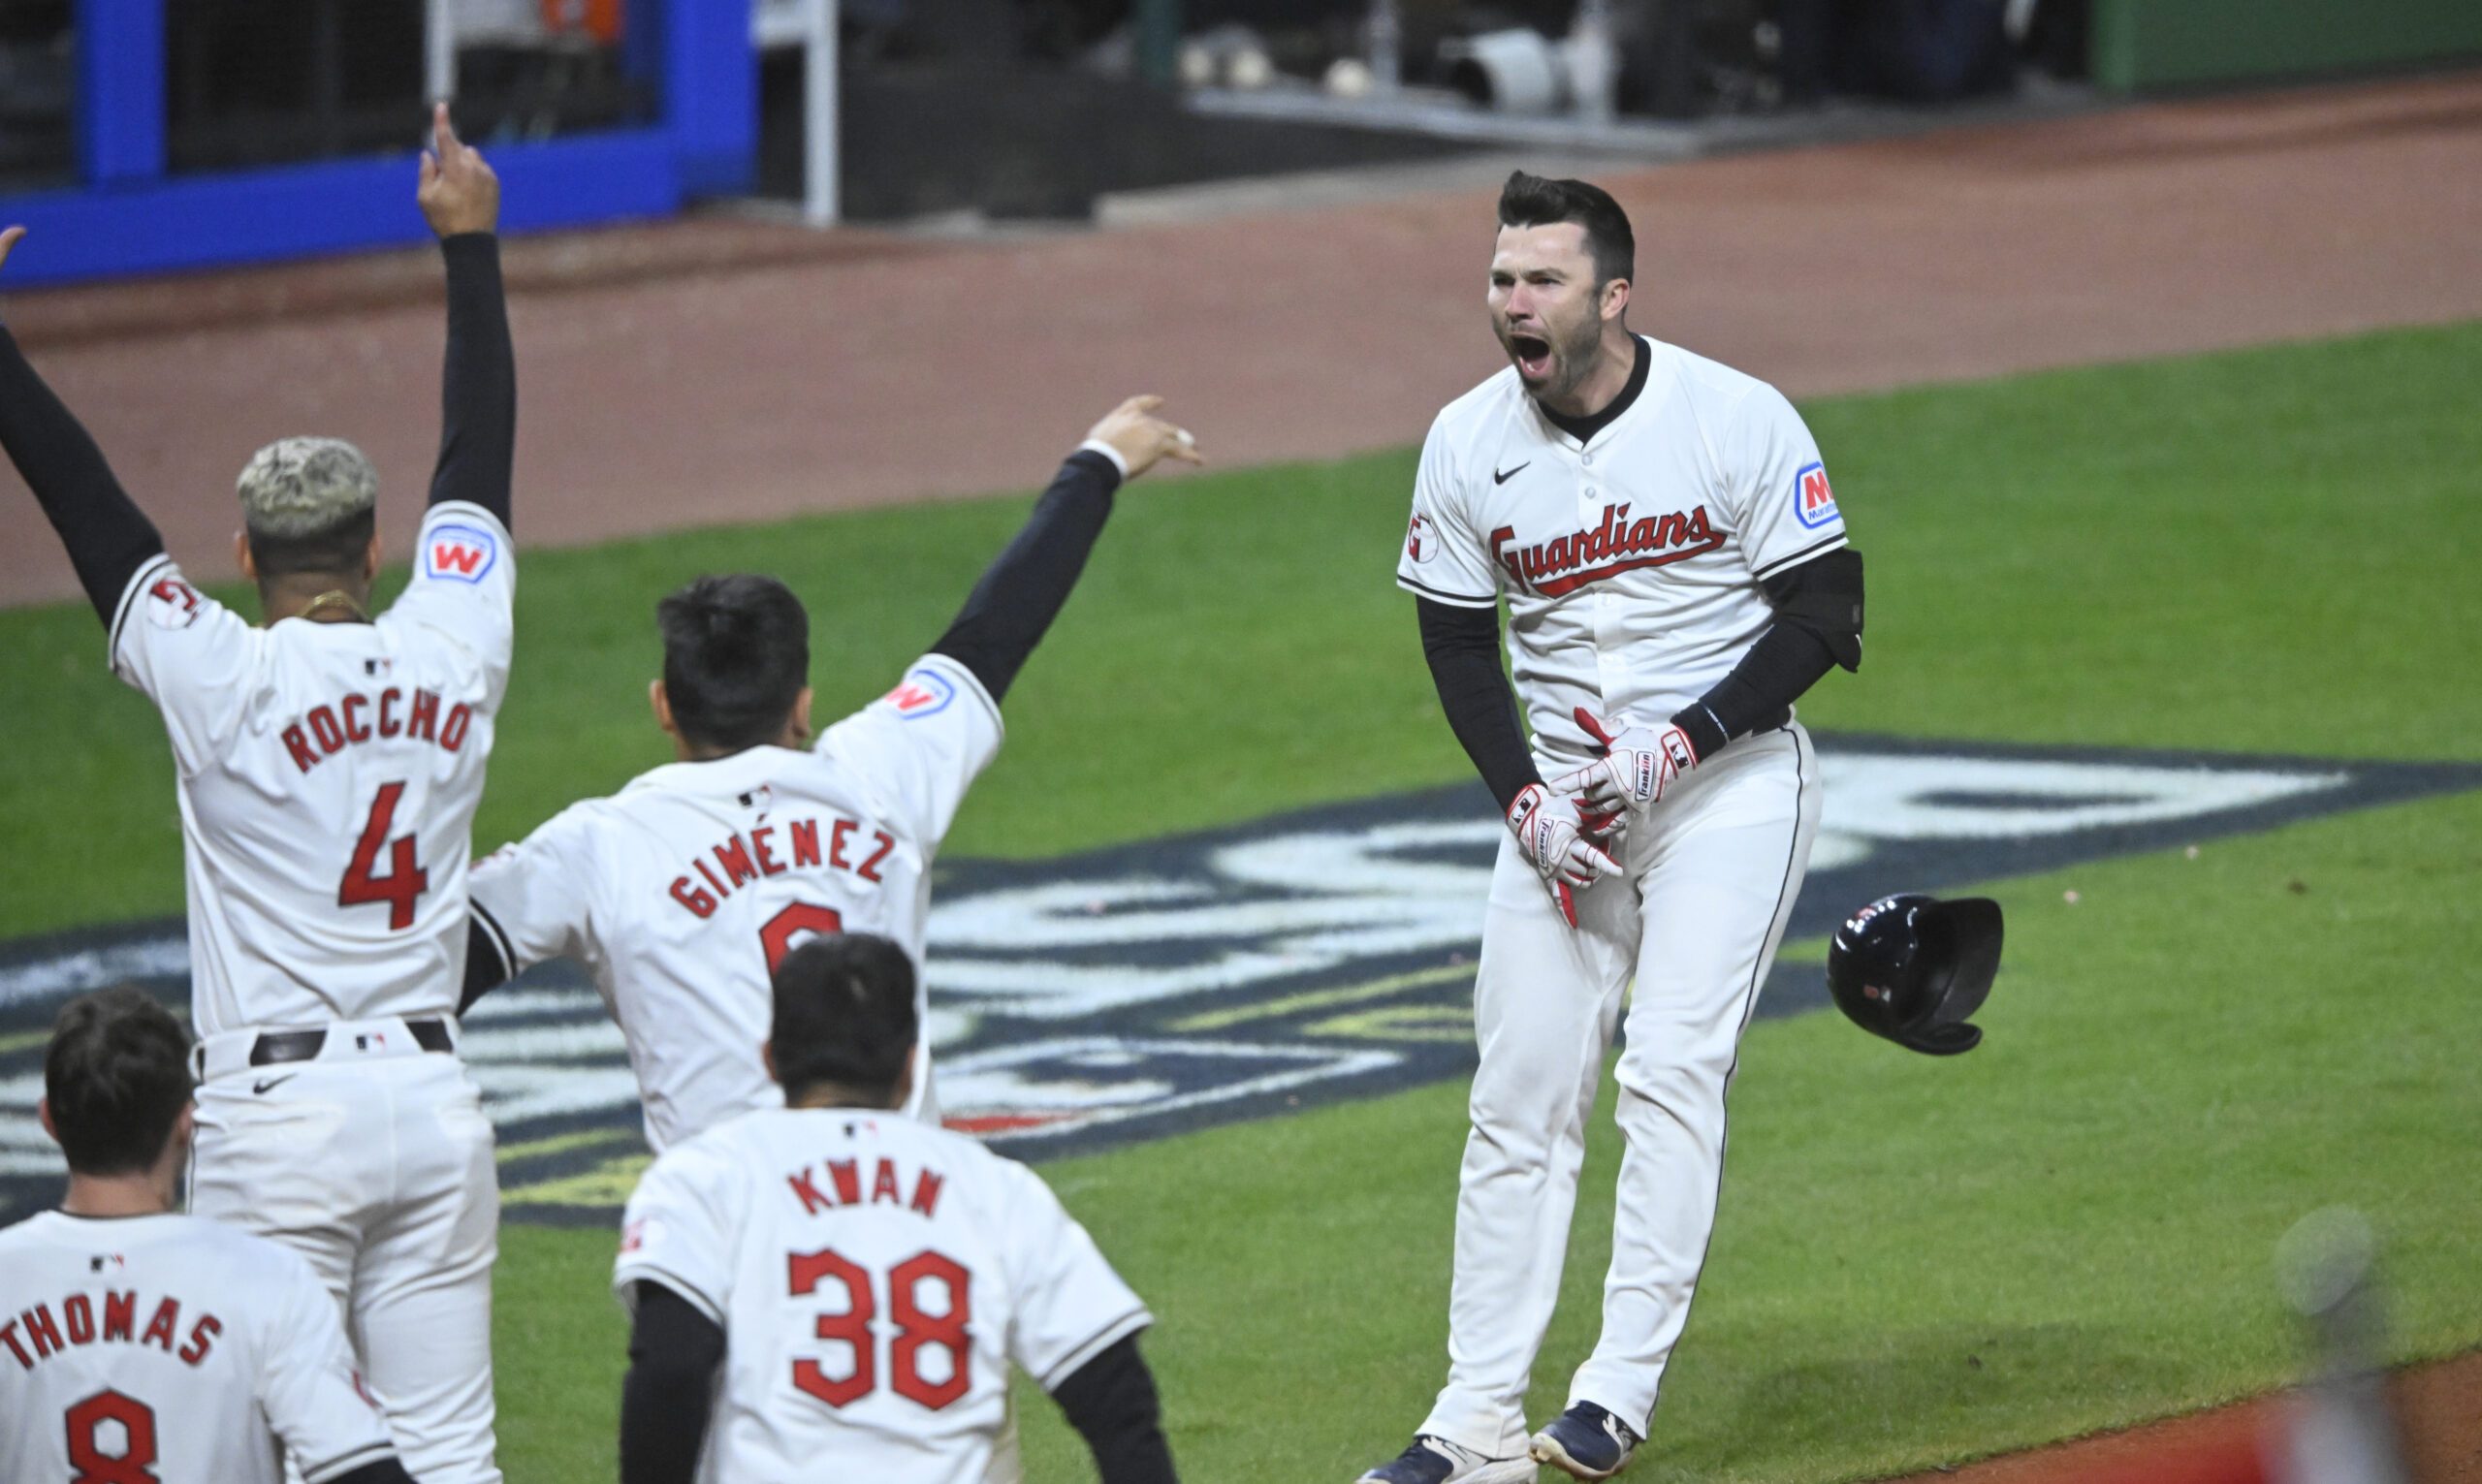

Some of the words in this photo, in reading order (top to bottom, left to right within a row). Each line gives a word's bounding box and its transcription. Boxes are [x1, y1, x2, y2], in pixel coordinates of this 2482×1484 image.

[1491, 502, 1728, 597] Guardians
[338, 779, 428, 931] 4
[669, 813, 895, 918] GIMÉNEZ
[786, 1157, 945, 1218] KWAN
[0, 1289, 223, 1371] THOMAS
[787, 1247, 971, 1410] 38
[65, 1387, 161, 1484] 8
